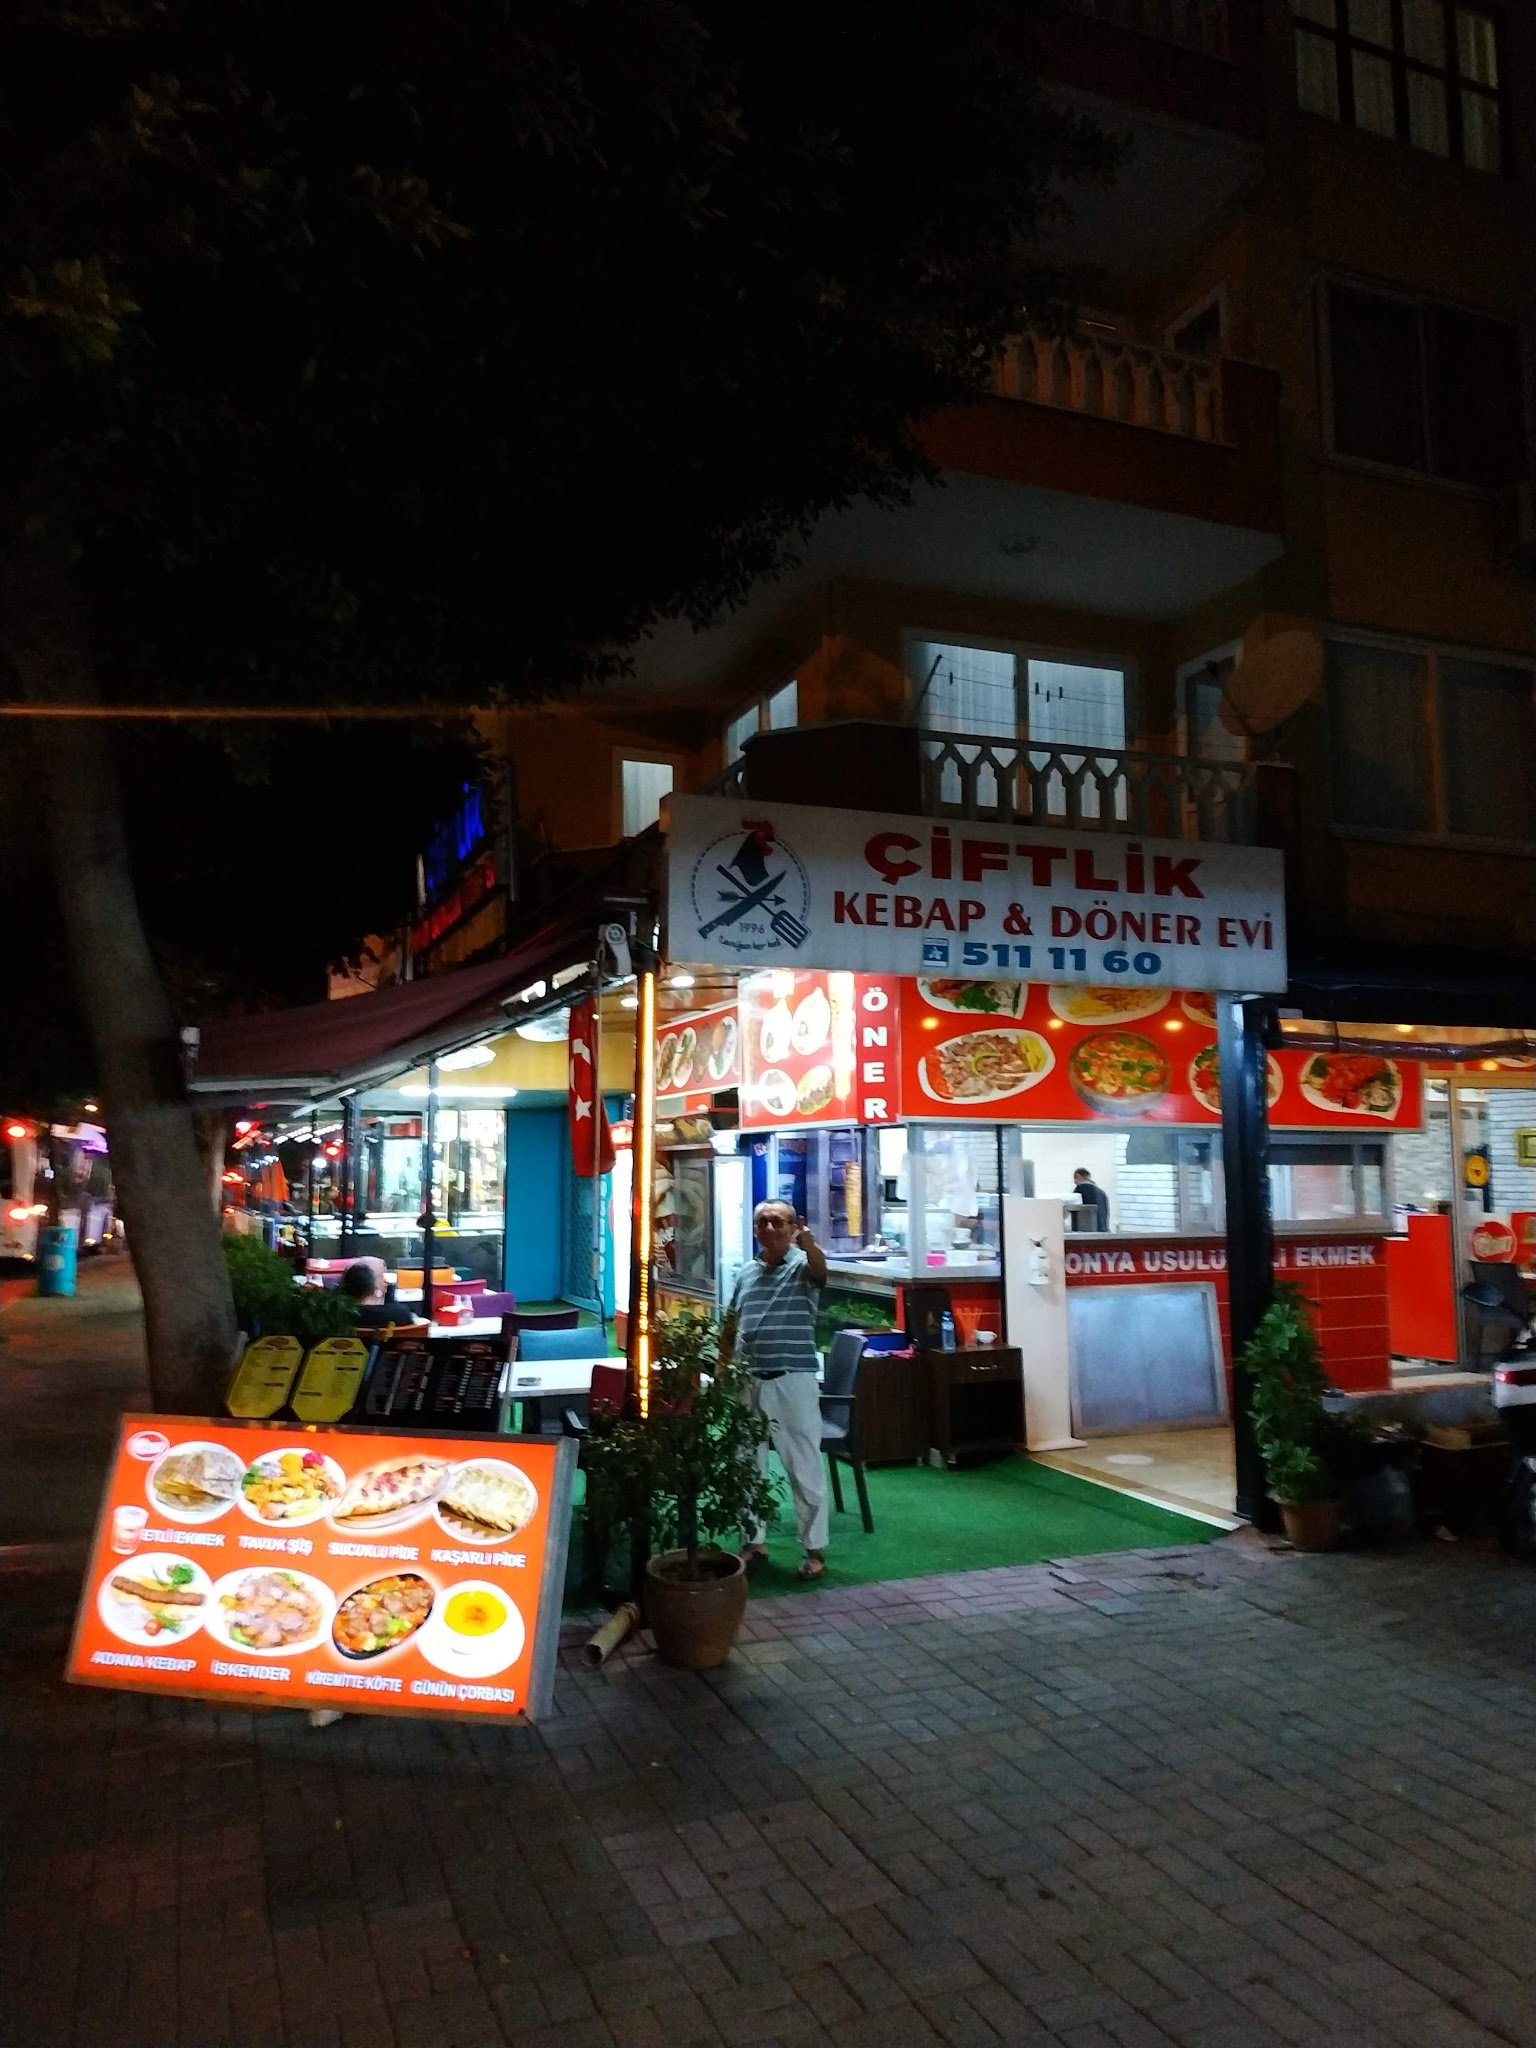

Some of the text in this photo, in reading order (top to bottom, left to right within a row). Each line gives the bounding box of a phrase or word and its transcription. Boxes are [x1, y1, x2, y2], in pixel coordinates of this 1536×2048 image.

[864, 826, 1205, 899] ÇİFTLİK
[739, 922, 766, 934] 1996
[834, 890, 1273, 950] KEBAP & DÖNER EVİ
[962, 942, 1162, 975] 511 11 60
[861, 986, 889, 1119] ÖNER
[1065, 1251, 1136, 1274] ONYA
[1143, 1249, 1227, 1272] USULÜ
[1295, 1246, 1375, 1267] EKMEK
[238, 1535, 286, 1551] TAVUK
[491, 1551, 526, 1568] PİDE
[365, 1674, 403, 1693] KÖFTE
[410, 1679, 515, 1703] GÜNÜN ÇORBASI
